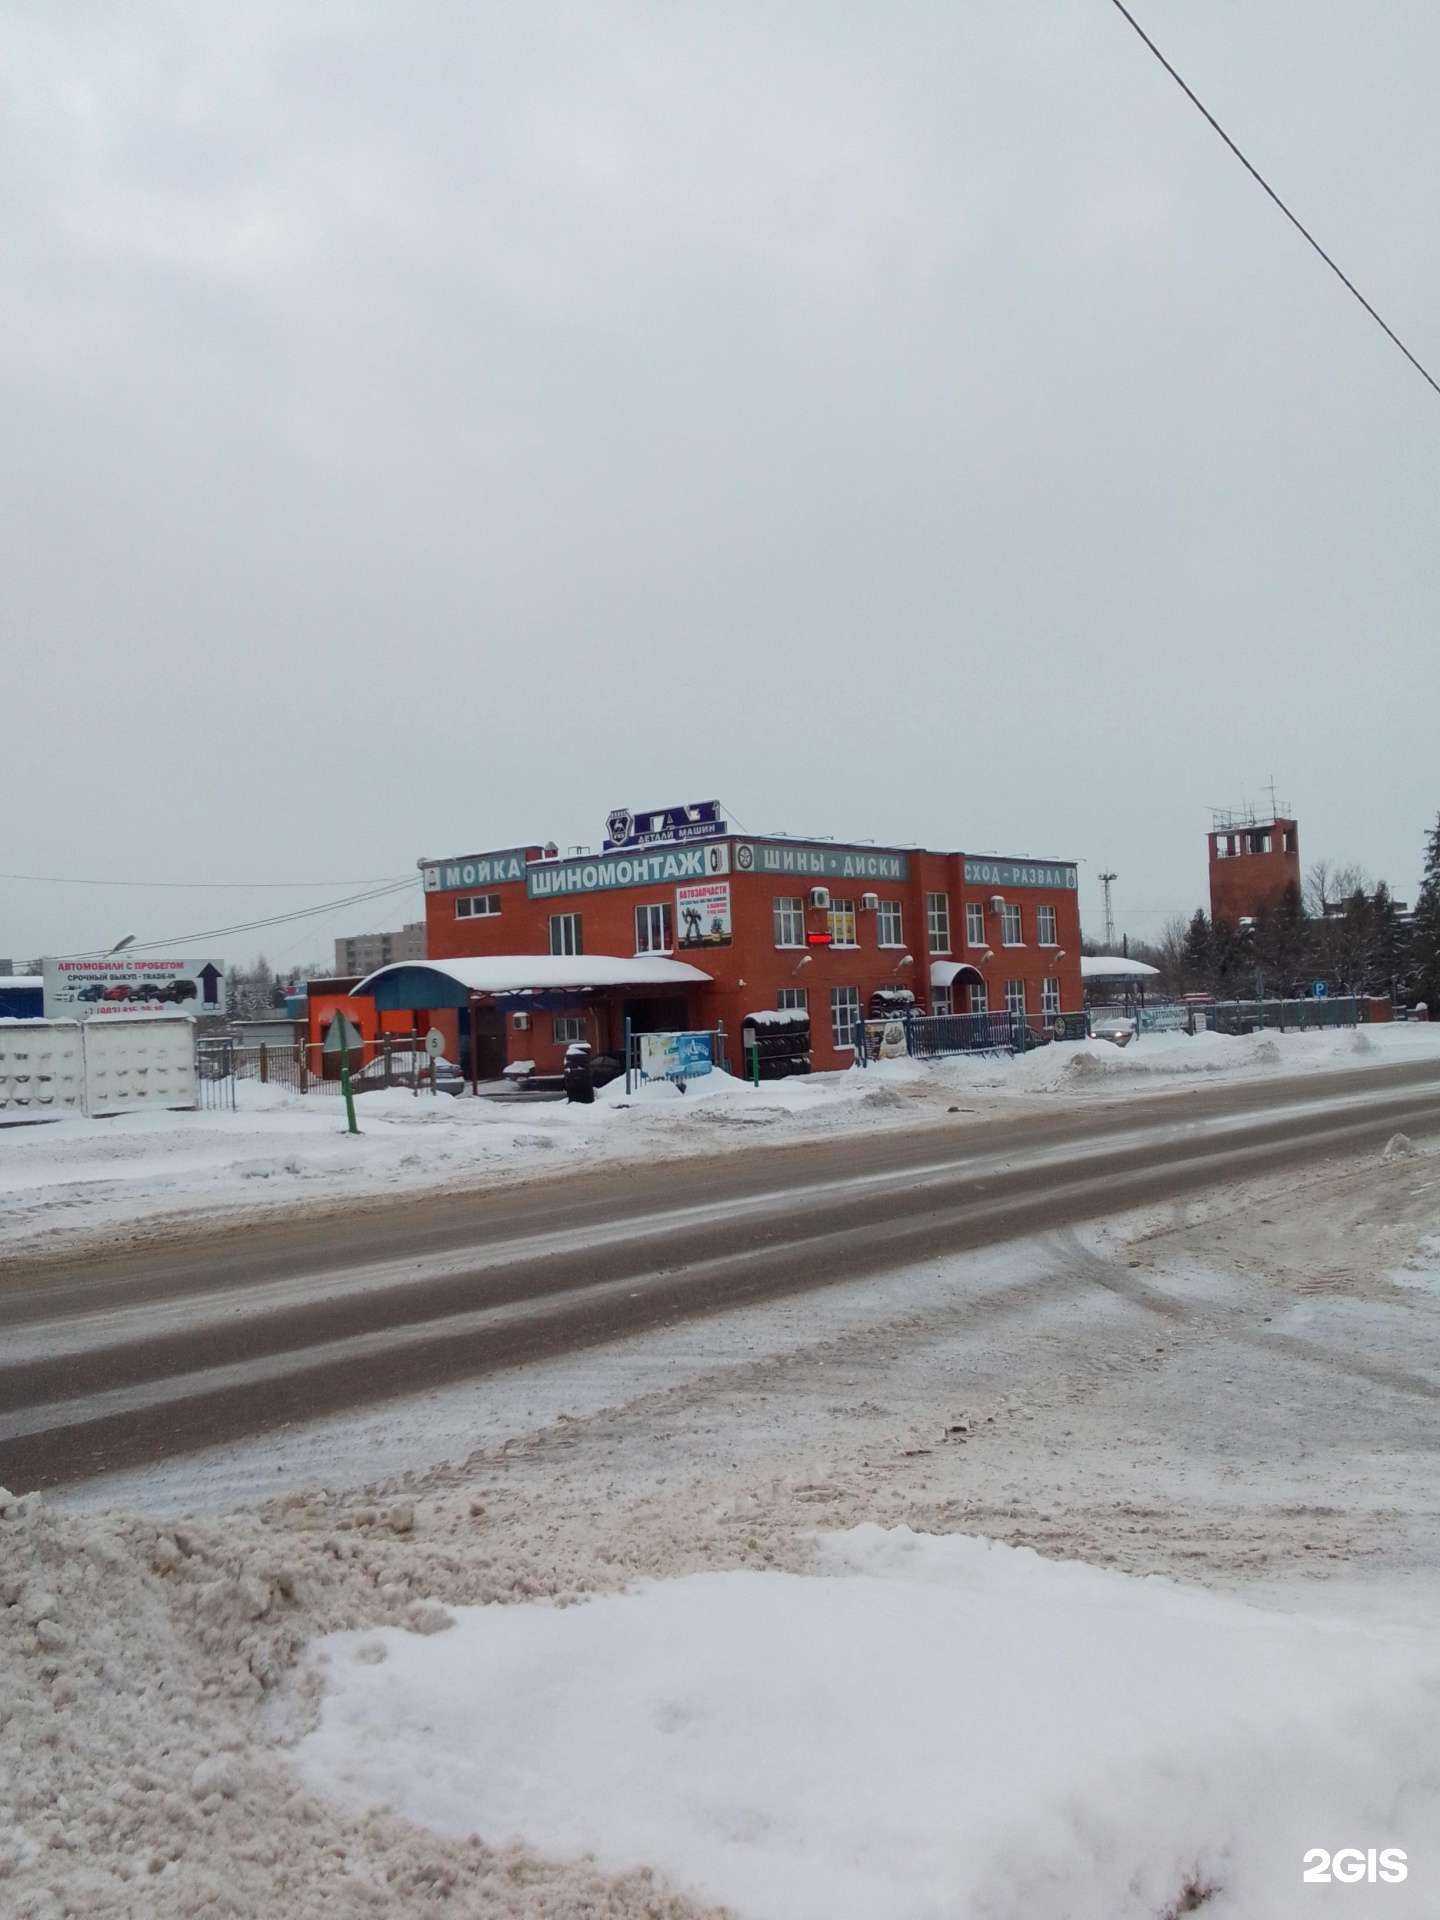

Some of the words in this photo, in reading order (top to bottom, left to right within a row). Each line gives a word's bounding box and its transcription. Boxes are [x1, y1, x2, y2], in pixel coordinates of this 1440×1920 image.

[638, 831, 674, 843] ДЕТАЛИ
[678, 824, 715, 837] МАШИН
[764, 848, 824, 873] ШИНЫ
[843, 856, 900, 878] ДИСКИ
[446, 859, 521, 887] МОЙКА
[532, 851, 703, 894] ШИНОМОНТАЖ
[964, 867, 1000, 884] СХОД
[1013, 868, 1061, 884] РАЗВАЛ
[680, 886, 727, 899] АВТОЗАПЧАСТИ
[58, 962, 124, 971] АВТОМОБИЛИ
[127, 962, 133, 970] С
[134, 962, 184, 971] ПРОБЕГОМ
[67, 973, 107, 981] СРОЧНЫЙ
[109, 973, 137, 981] ВЫКУП
[1316, 983, 1324, 995] P
